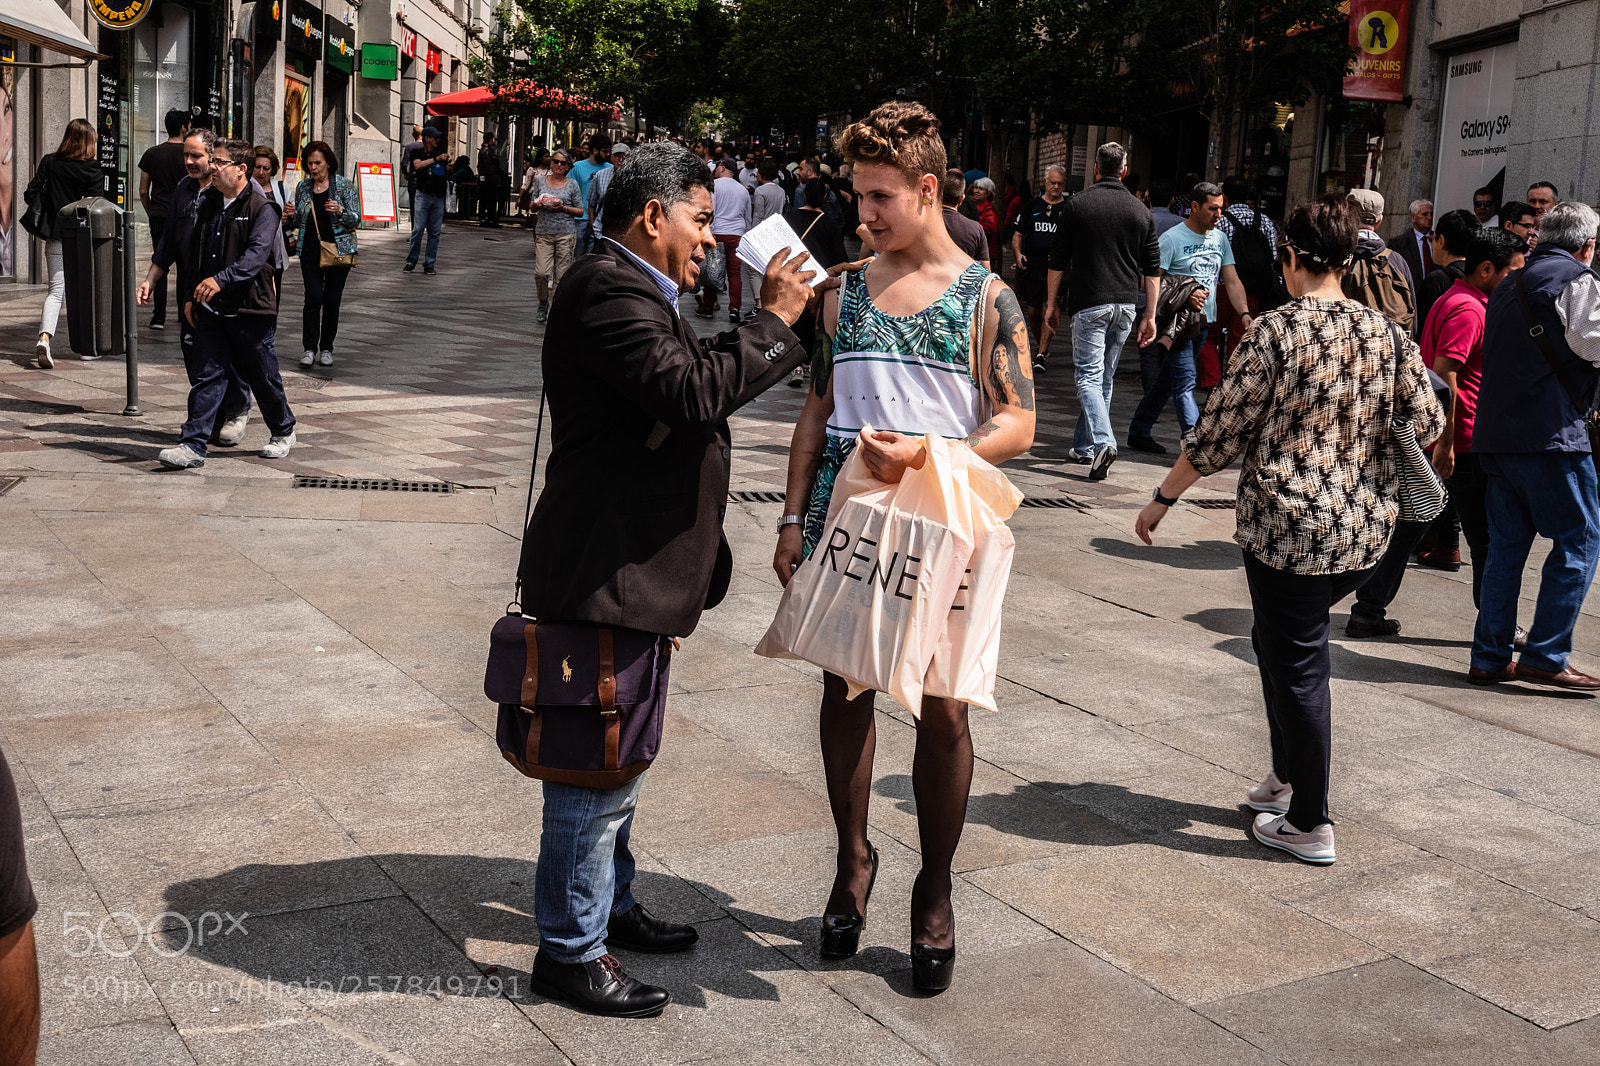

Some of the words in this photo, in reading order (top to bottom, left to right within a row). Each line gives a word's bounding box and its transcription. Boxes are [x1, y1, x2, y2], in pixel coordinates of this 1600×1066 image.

[291, 13, 306, 30] Madrid
[402, 26, 415, 57] KFC
[363, 57, 397, 67] codere
[1347, 59, 1401, 72] SOUVENIRS
[1450, 60, 1482, 78] SAMSUNG
[1382, 72, 1401, 80] GIFTS
[1460, 119, 1496, 141] Galaxy
[848, 394, 925, 405] HAWAII
